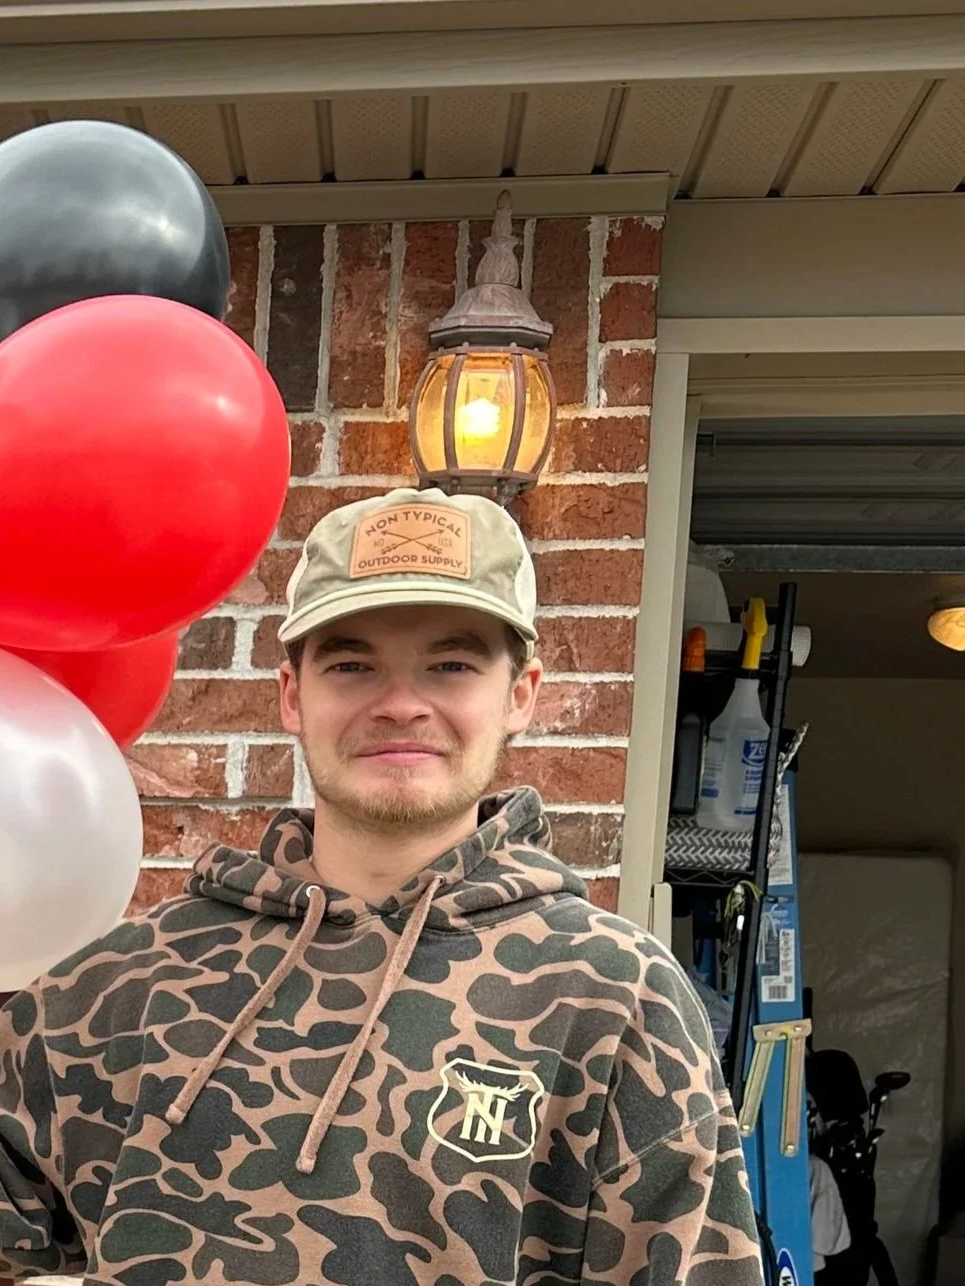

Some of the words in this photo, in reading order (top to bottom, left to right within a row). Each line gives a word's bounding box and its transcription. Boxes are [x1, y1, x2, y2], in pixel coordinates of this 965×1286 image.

[365, 514, 398, 537] NON
[403, 511, 463, 537] TYPICAL
[437, 537, 454, 548] USA
[358, 554, 419, 569] OUTDOOR
[421, 555, 464, 569] SUPPLY
